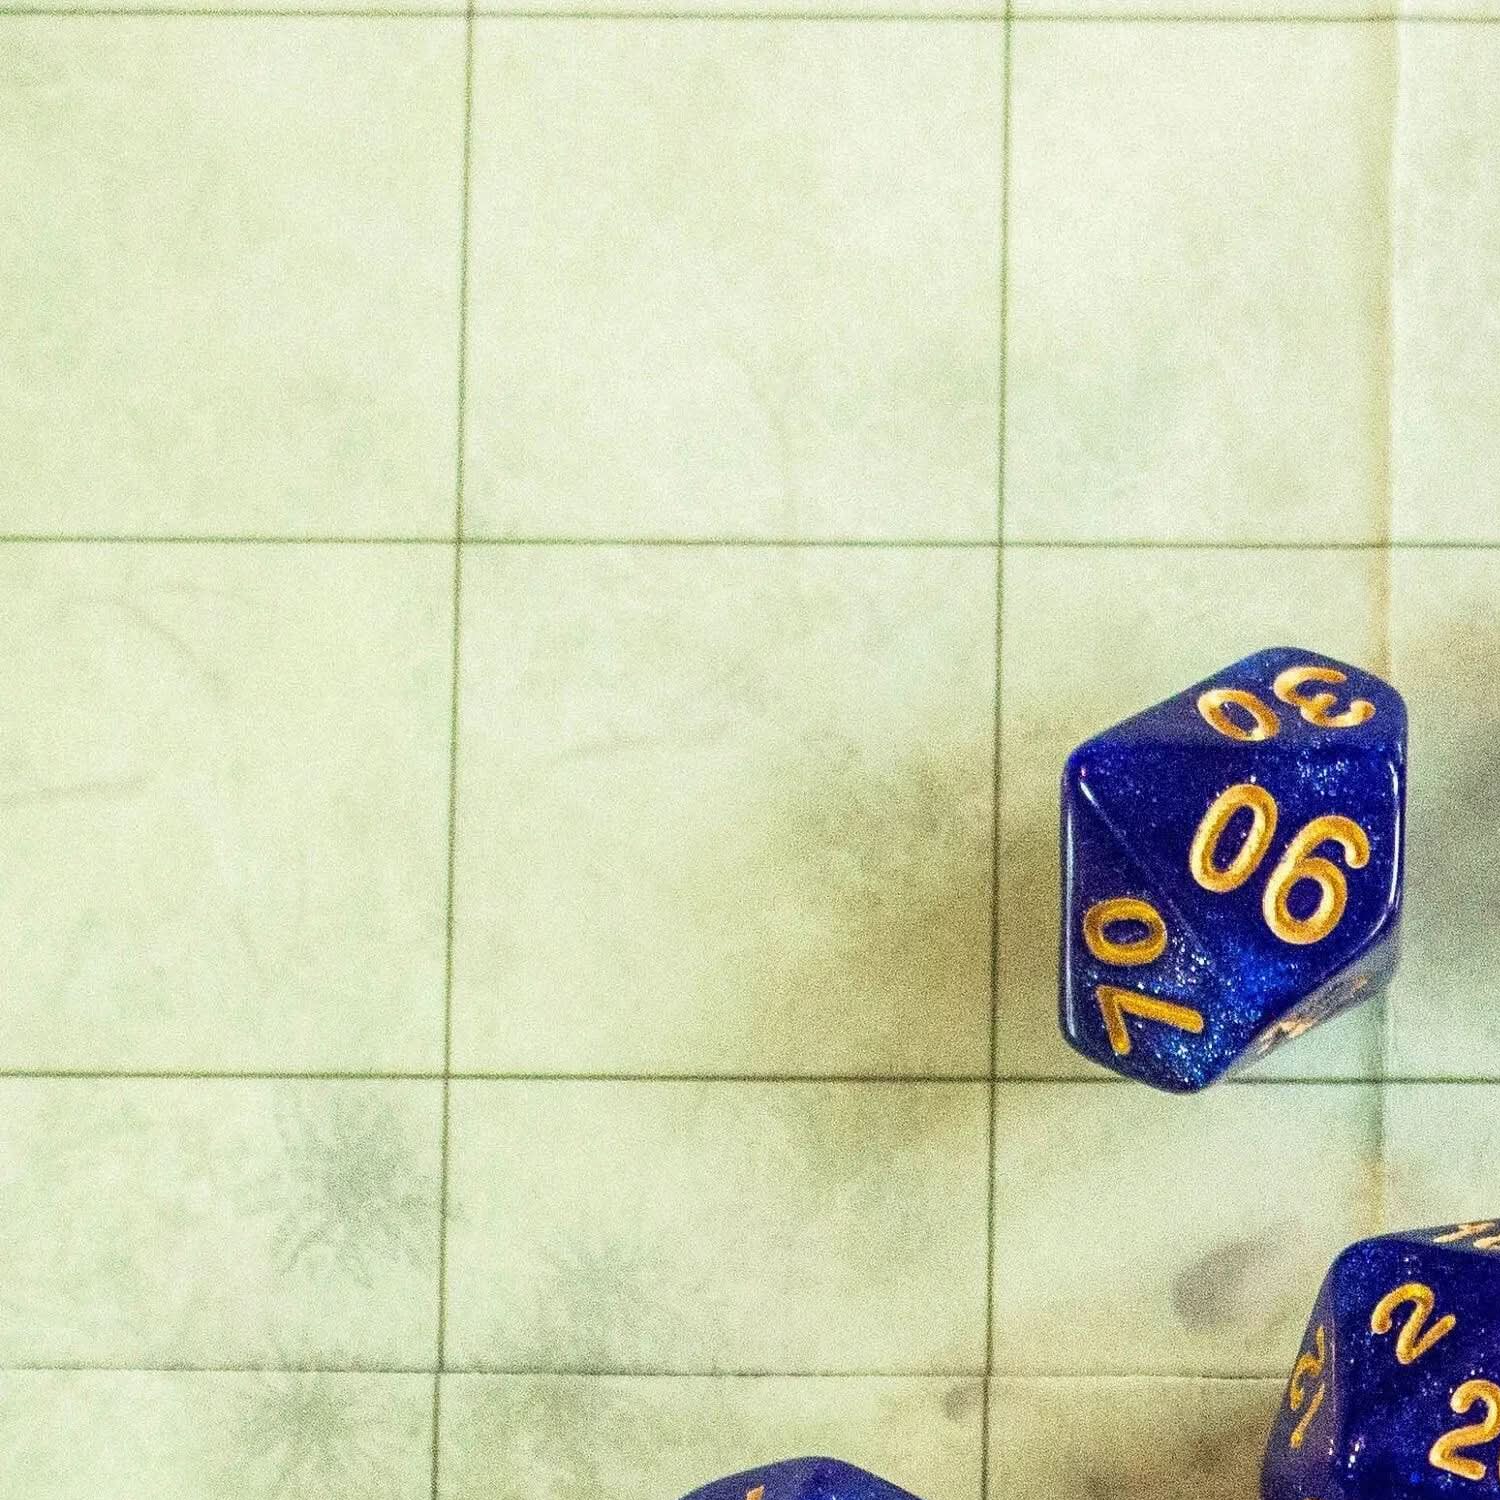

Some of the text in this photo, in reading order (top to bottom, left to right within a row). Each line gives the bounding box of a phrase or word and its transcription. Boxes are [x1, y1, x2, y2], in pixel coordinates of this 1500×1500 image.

[1197, 666, 1376, 742] 30
[1083, 896, 1205, 1056] 70
[1371, 1282, 1457, 1366] 2
